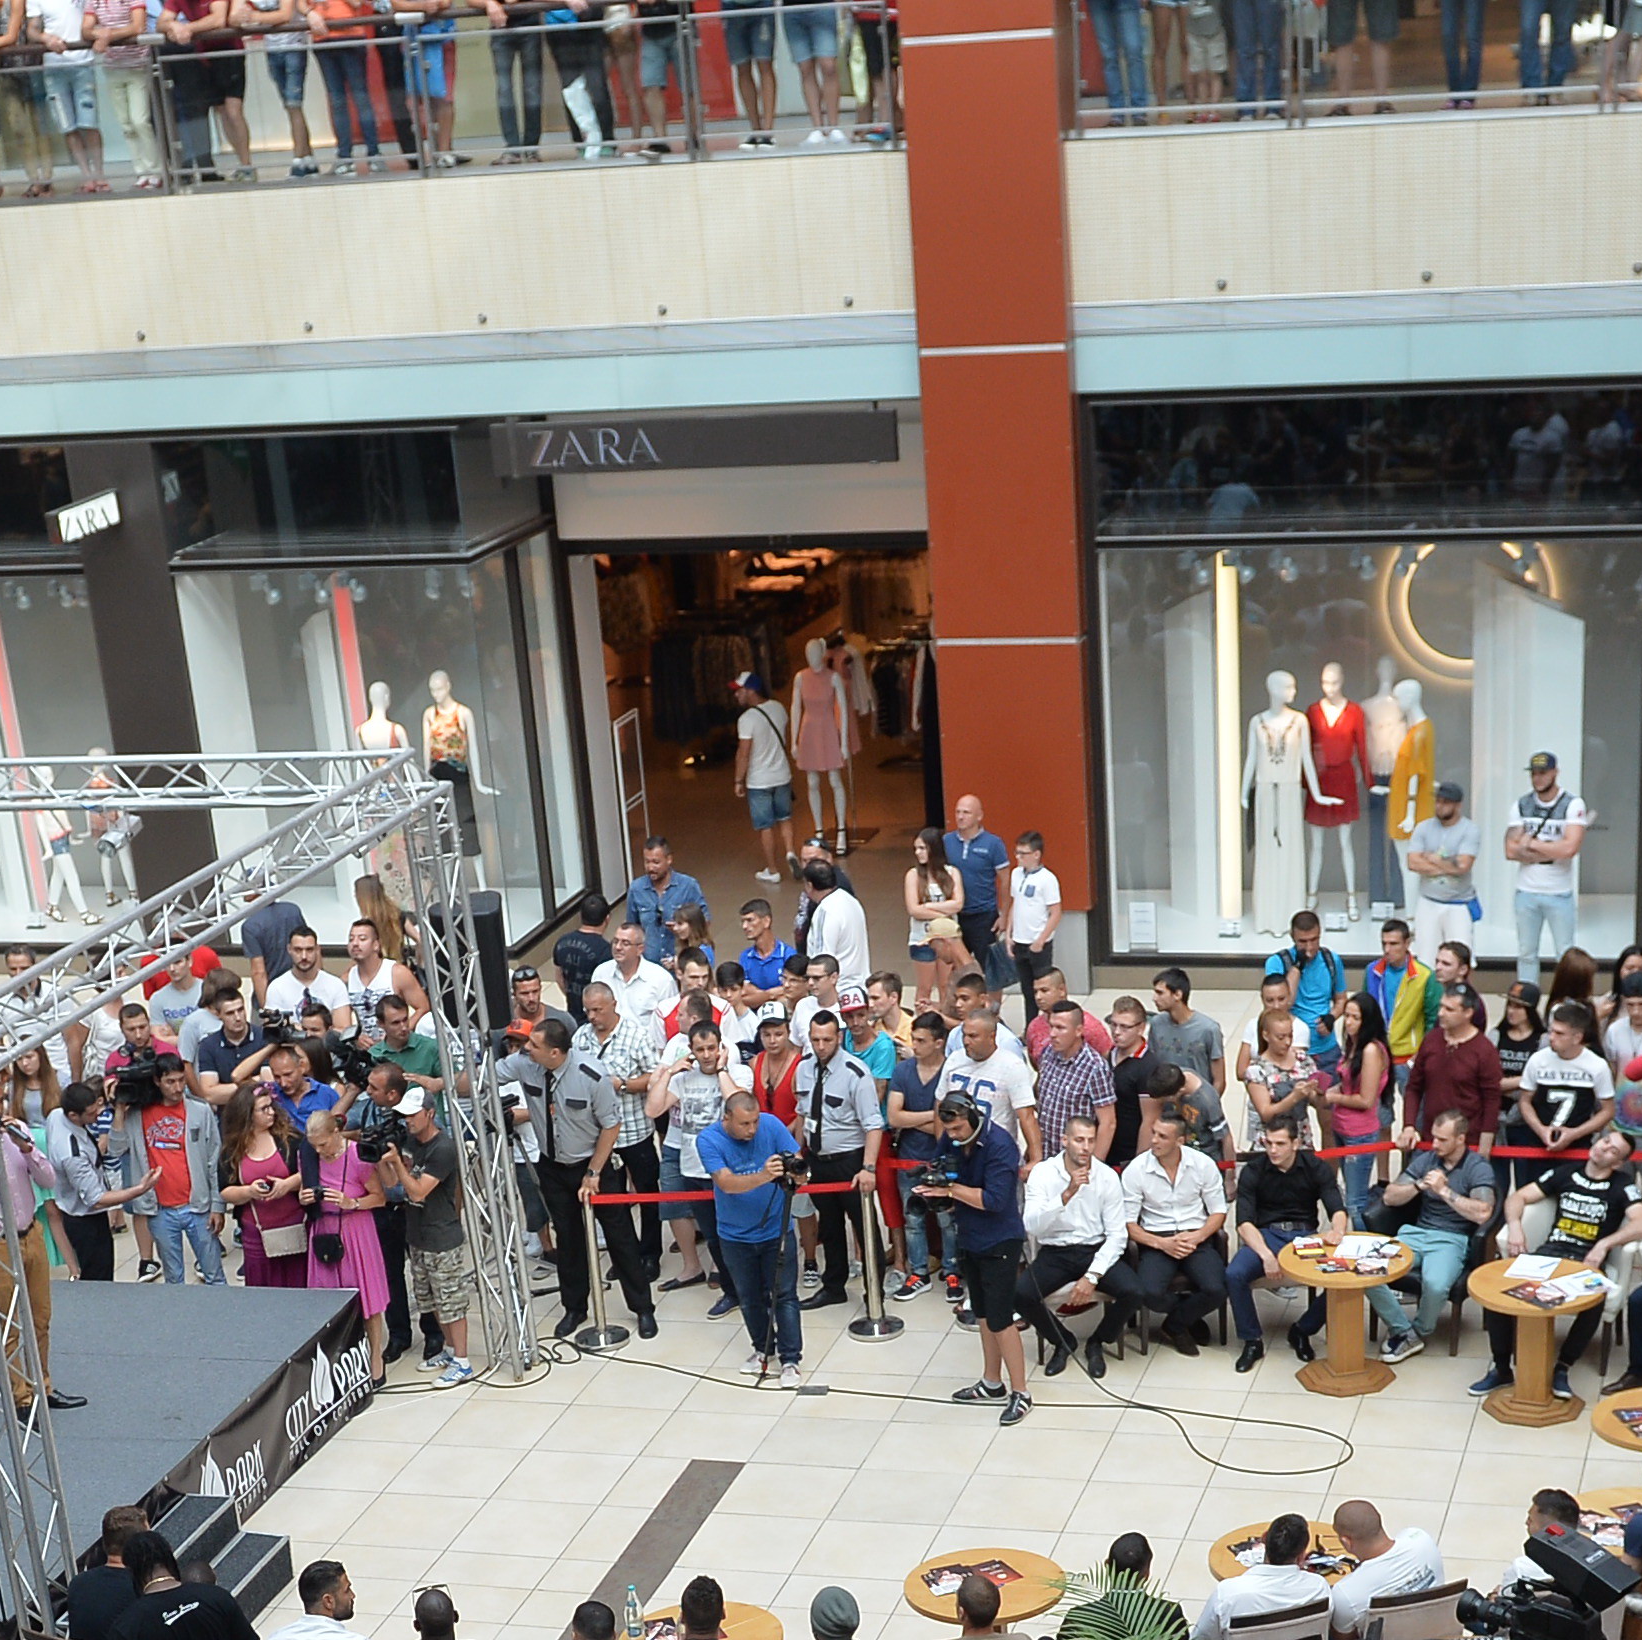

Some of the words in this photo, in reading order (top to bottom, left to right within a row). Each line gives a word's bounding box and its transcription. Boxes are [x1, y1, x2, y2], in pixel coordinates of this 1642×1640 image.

[526, 428, 663, 458] ZARA
[60, 507, 112, 542] ZARA
[1546, 1088, 1578, 1127] 7
[285, 1390, 310, 1442] CITY
[332, 1335, 372, 1396] PARK
[224, 1438, 264, 1496] PARK
